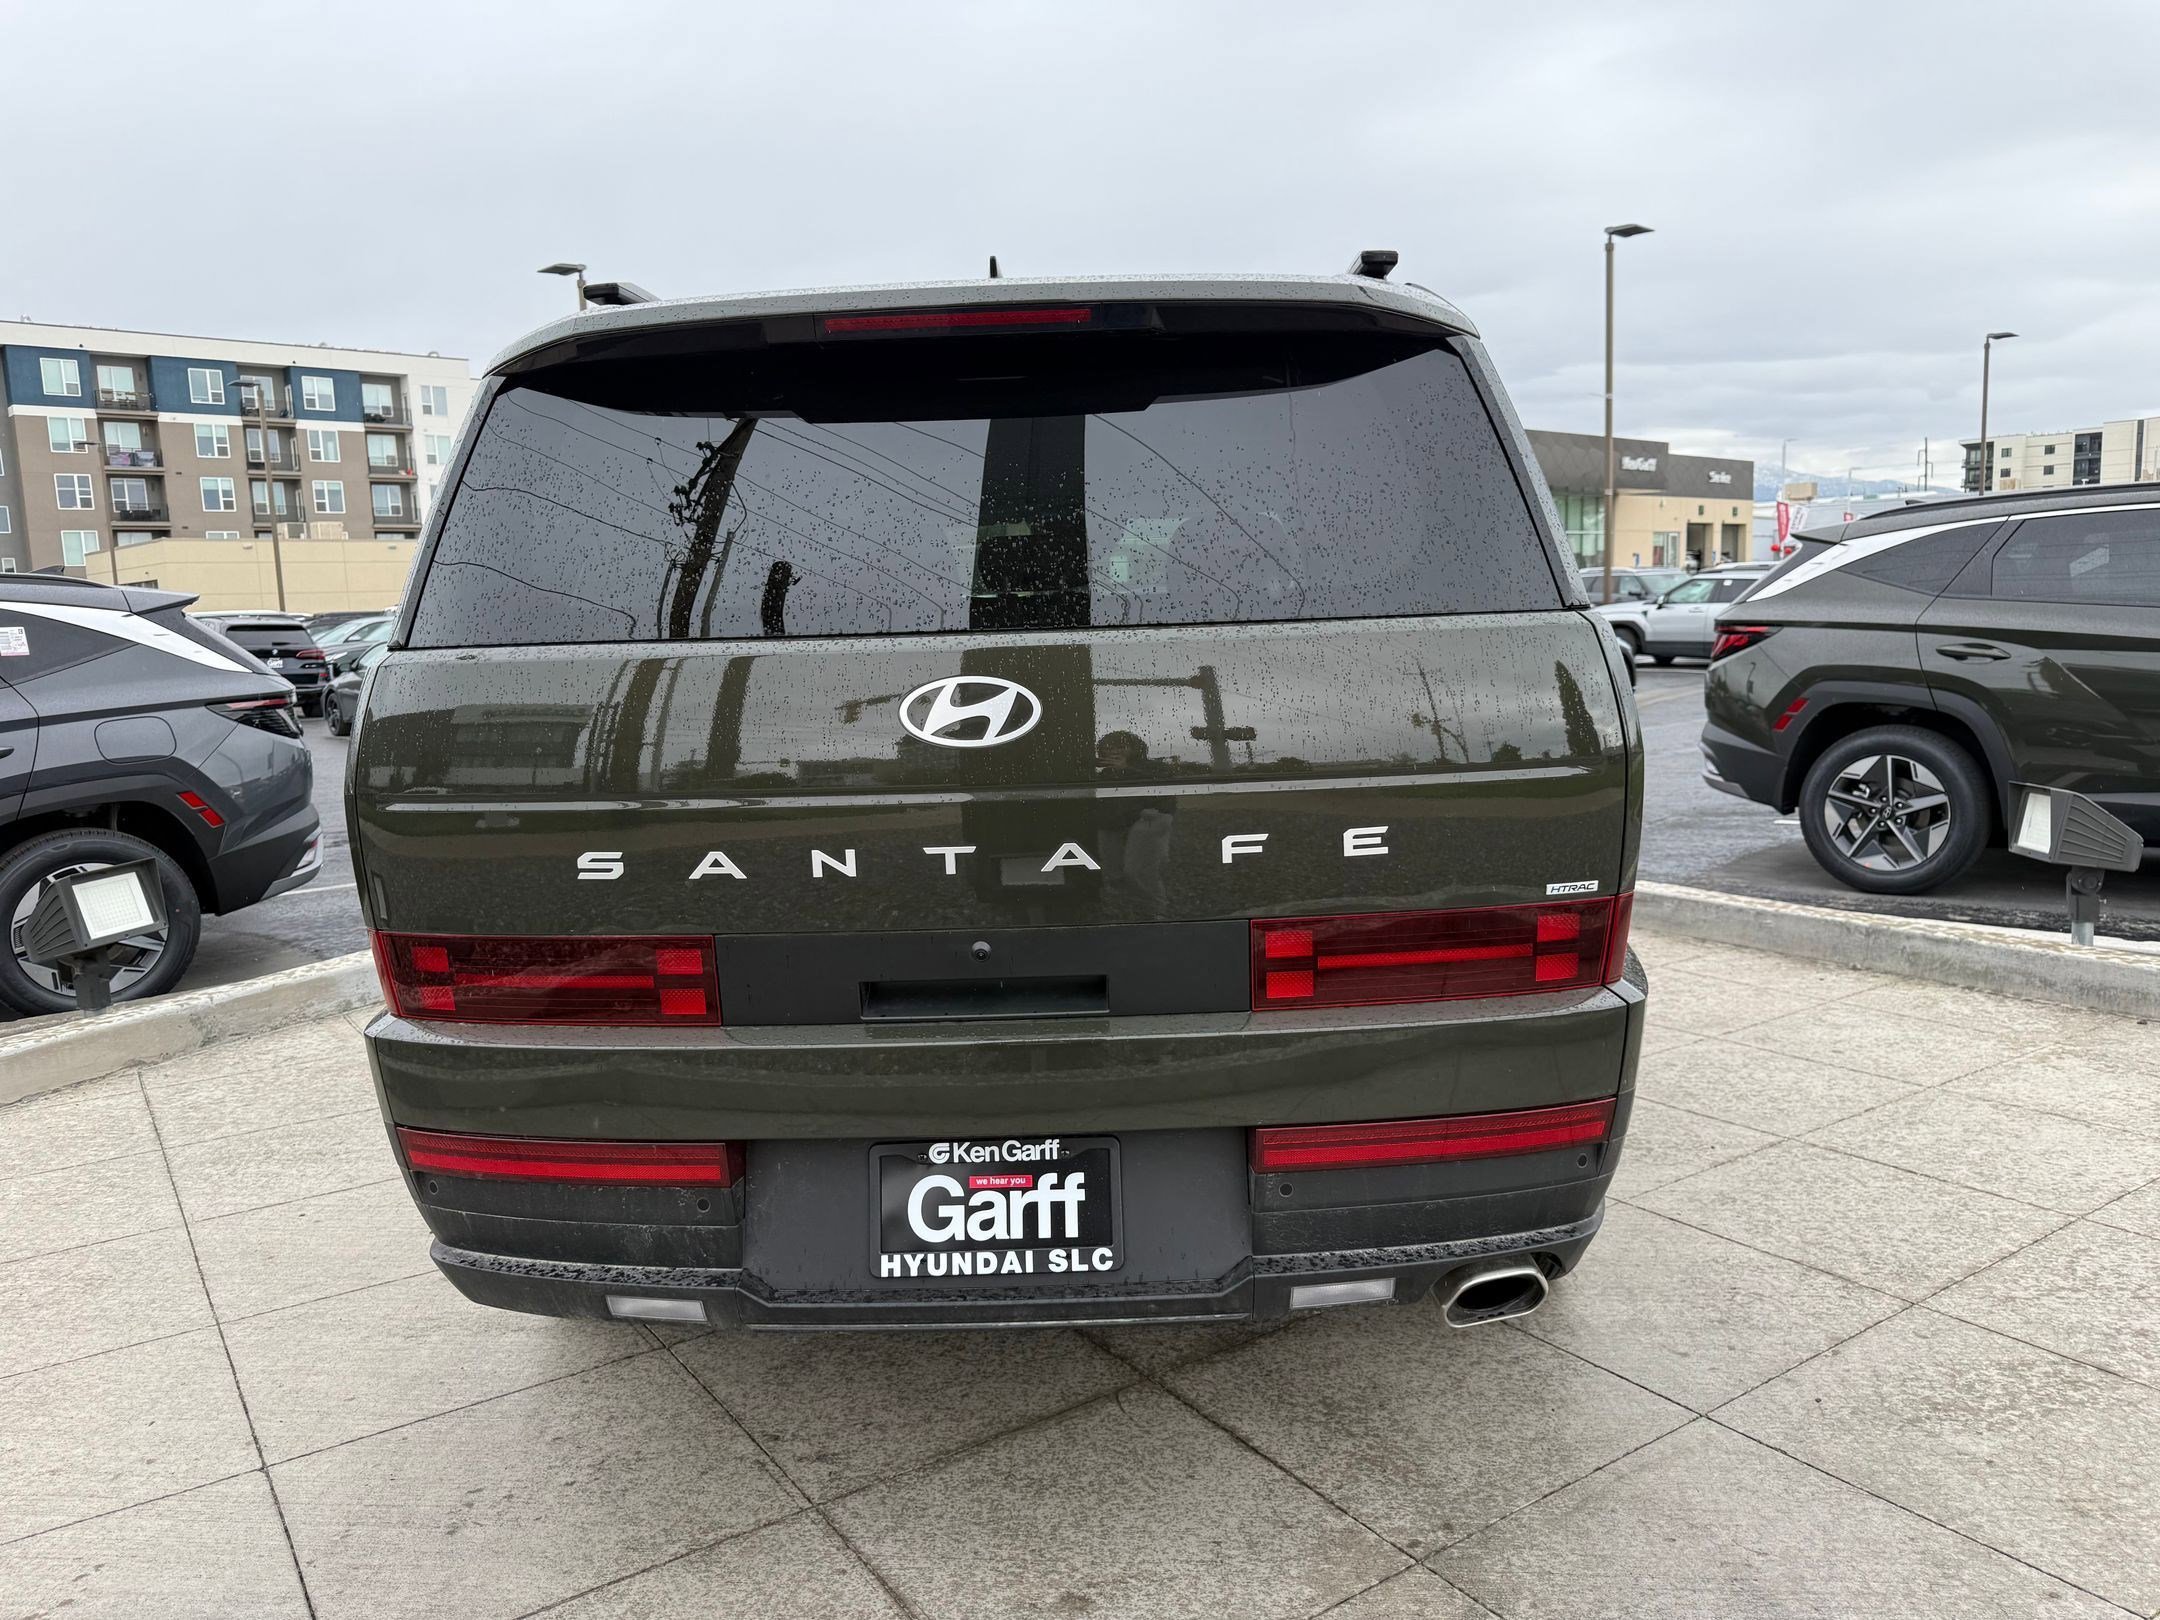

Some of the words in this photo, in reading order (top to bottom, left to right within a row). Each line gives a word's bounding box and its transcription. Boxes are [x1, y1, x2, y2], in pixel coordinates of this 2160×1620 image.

[576, 841, 1101, 880] SANTA
[1221, 825, 1390, 864] FE
[1550, 882, 1596, 894] HTRAC
[952, 1141, 999, 1163] Ken
[1001, 1138, 1060, 1162] Garff
[989, 1176, 1009, 1186] hear
[1010, 1177, 1026, 1187] you
[907, 1172, 1086, 1243] Garff
[880, 1250, 1034, 1278] HYUNDAI
[1047, 1247, 1114, 1274] SLC
